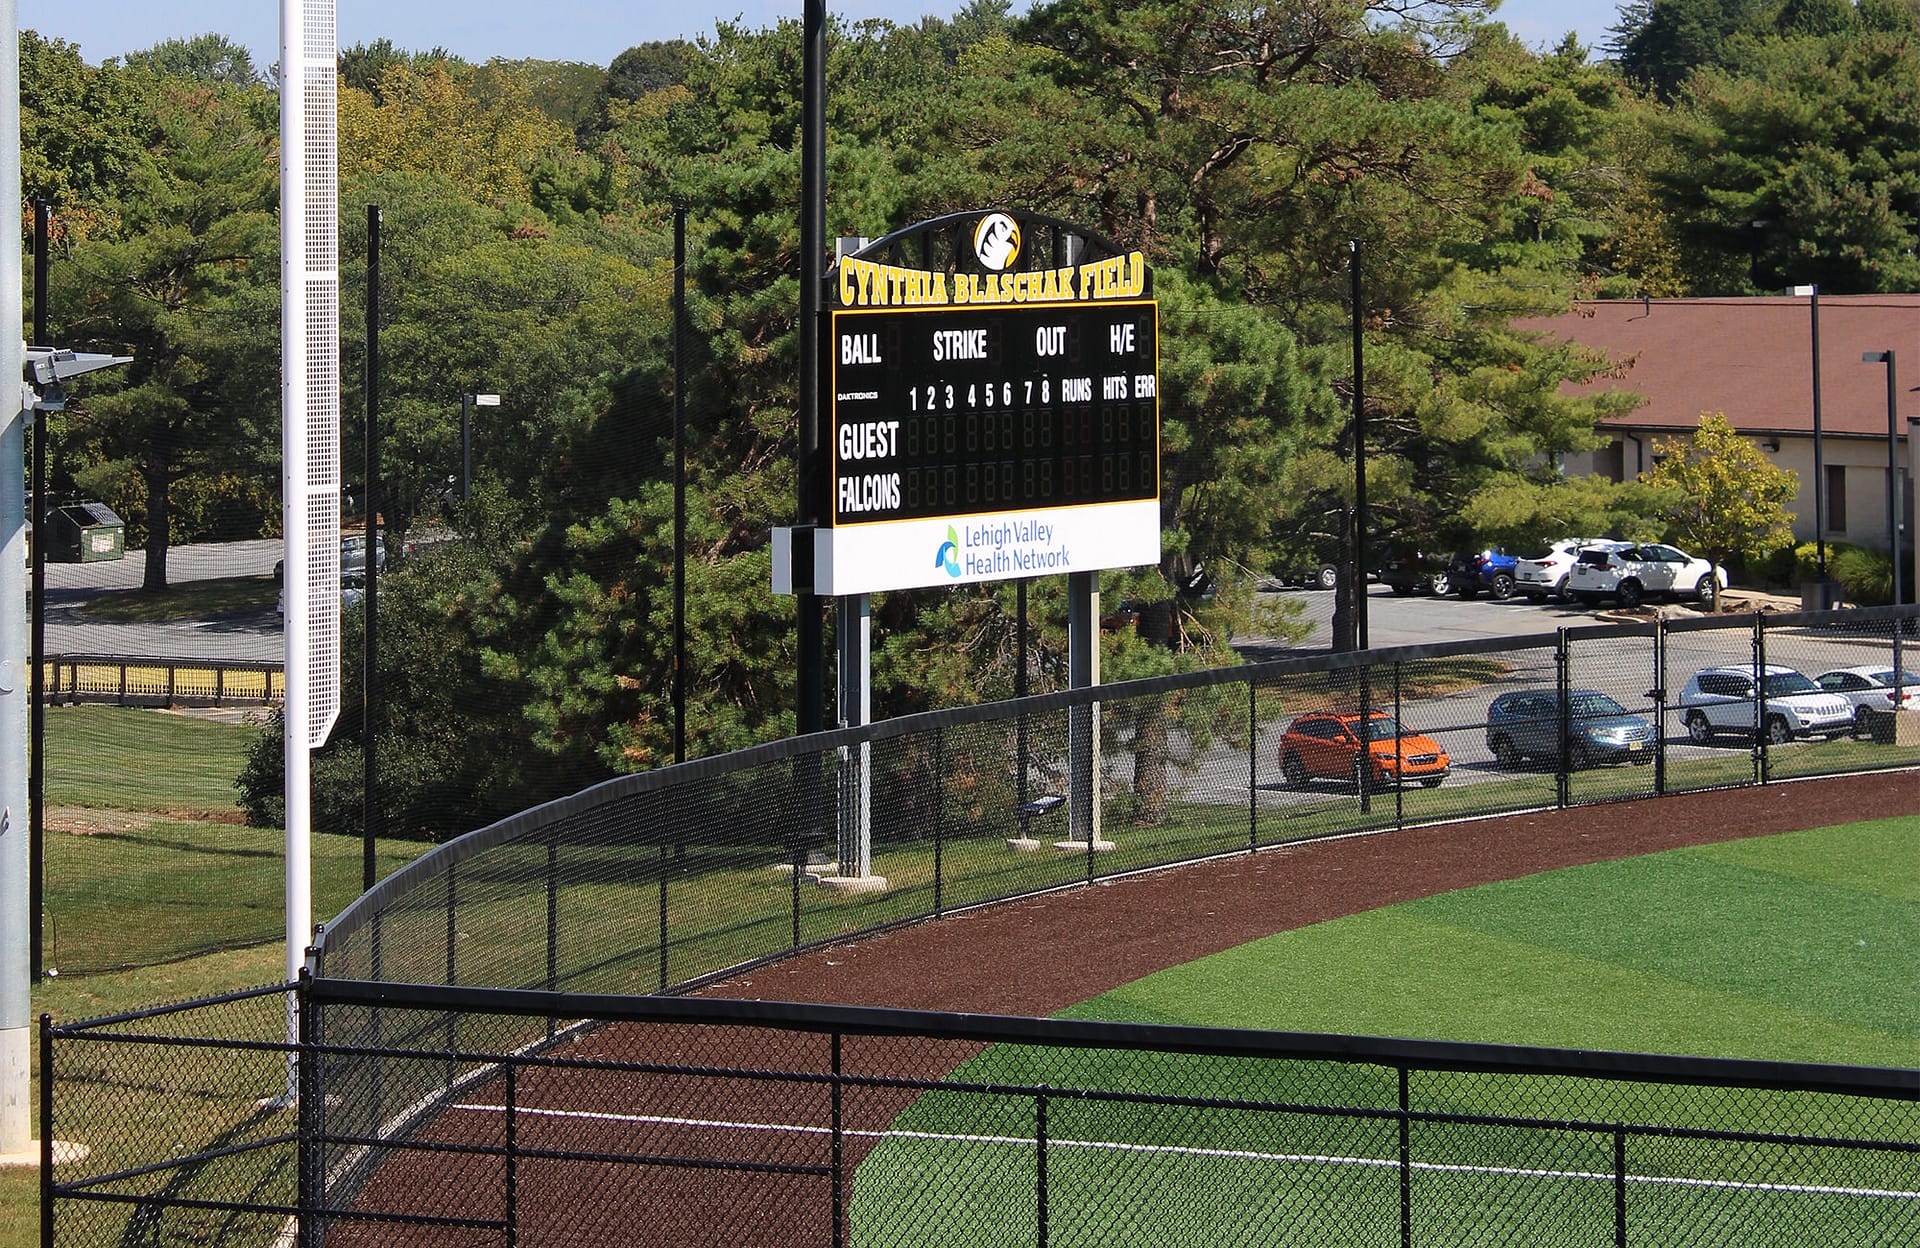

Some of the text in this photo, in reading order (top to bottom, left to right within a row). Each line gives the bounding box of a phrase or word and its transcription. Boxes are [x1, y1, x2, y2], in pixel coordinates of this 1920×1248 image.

[840, 251, 1145, 306] CYNTHIA BLASCHAK FIELD
[841, 323, 1135, 365] BALL STRIKE OUT H/E
[909, 374, 1156, 411] 1 2 3 4 5 6 7 8 RUNS HITS ERR
[839, 420, 900, 461] GUEST
[838, 472, 901, 513] FALCONS
[965, 519, 1054, 550] Lehigh Valley
[965, 544, 1070, 576] Health Network
